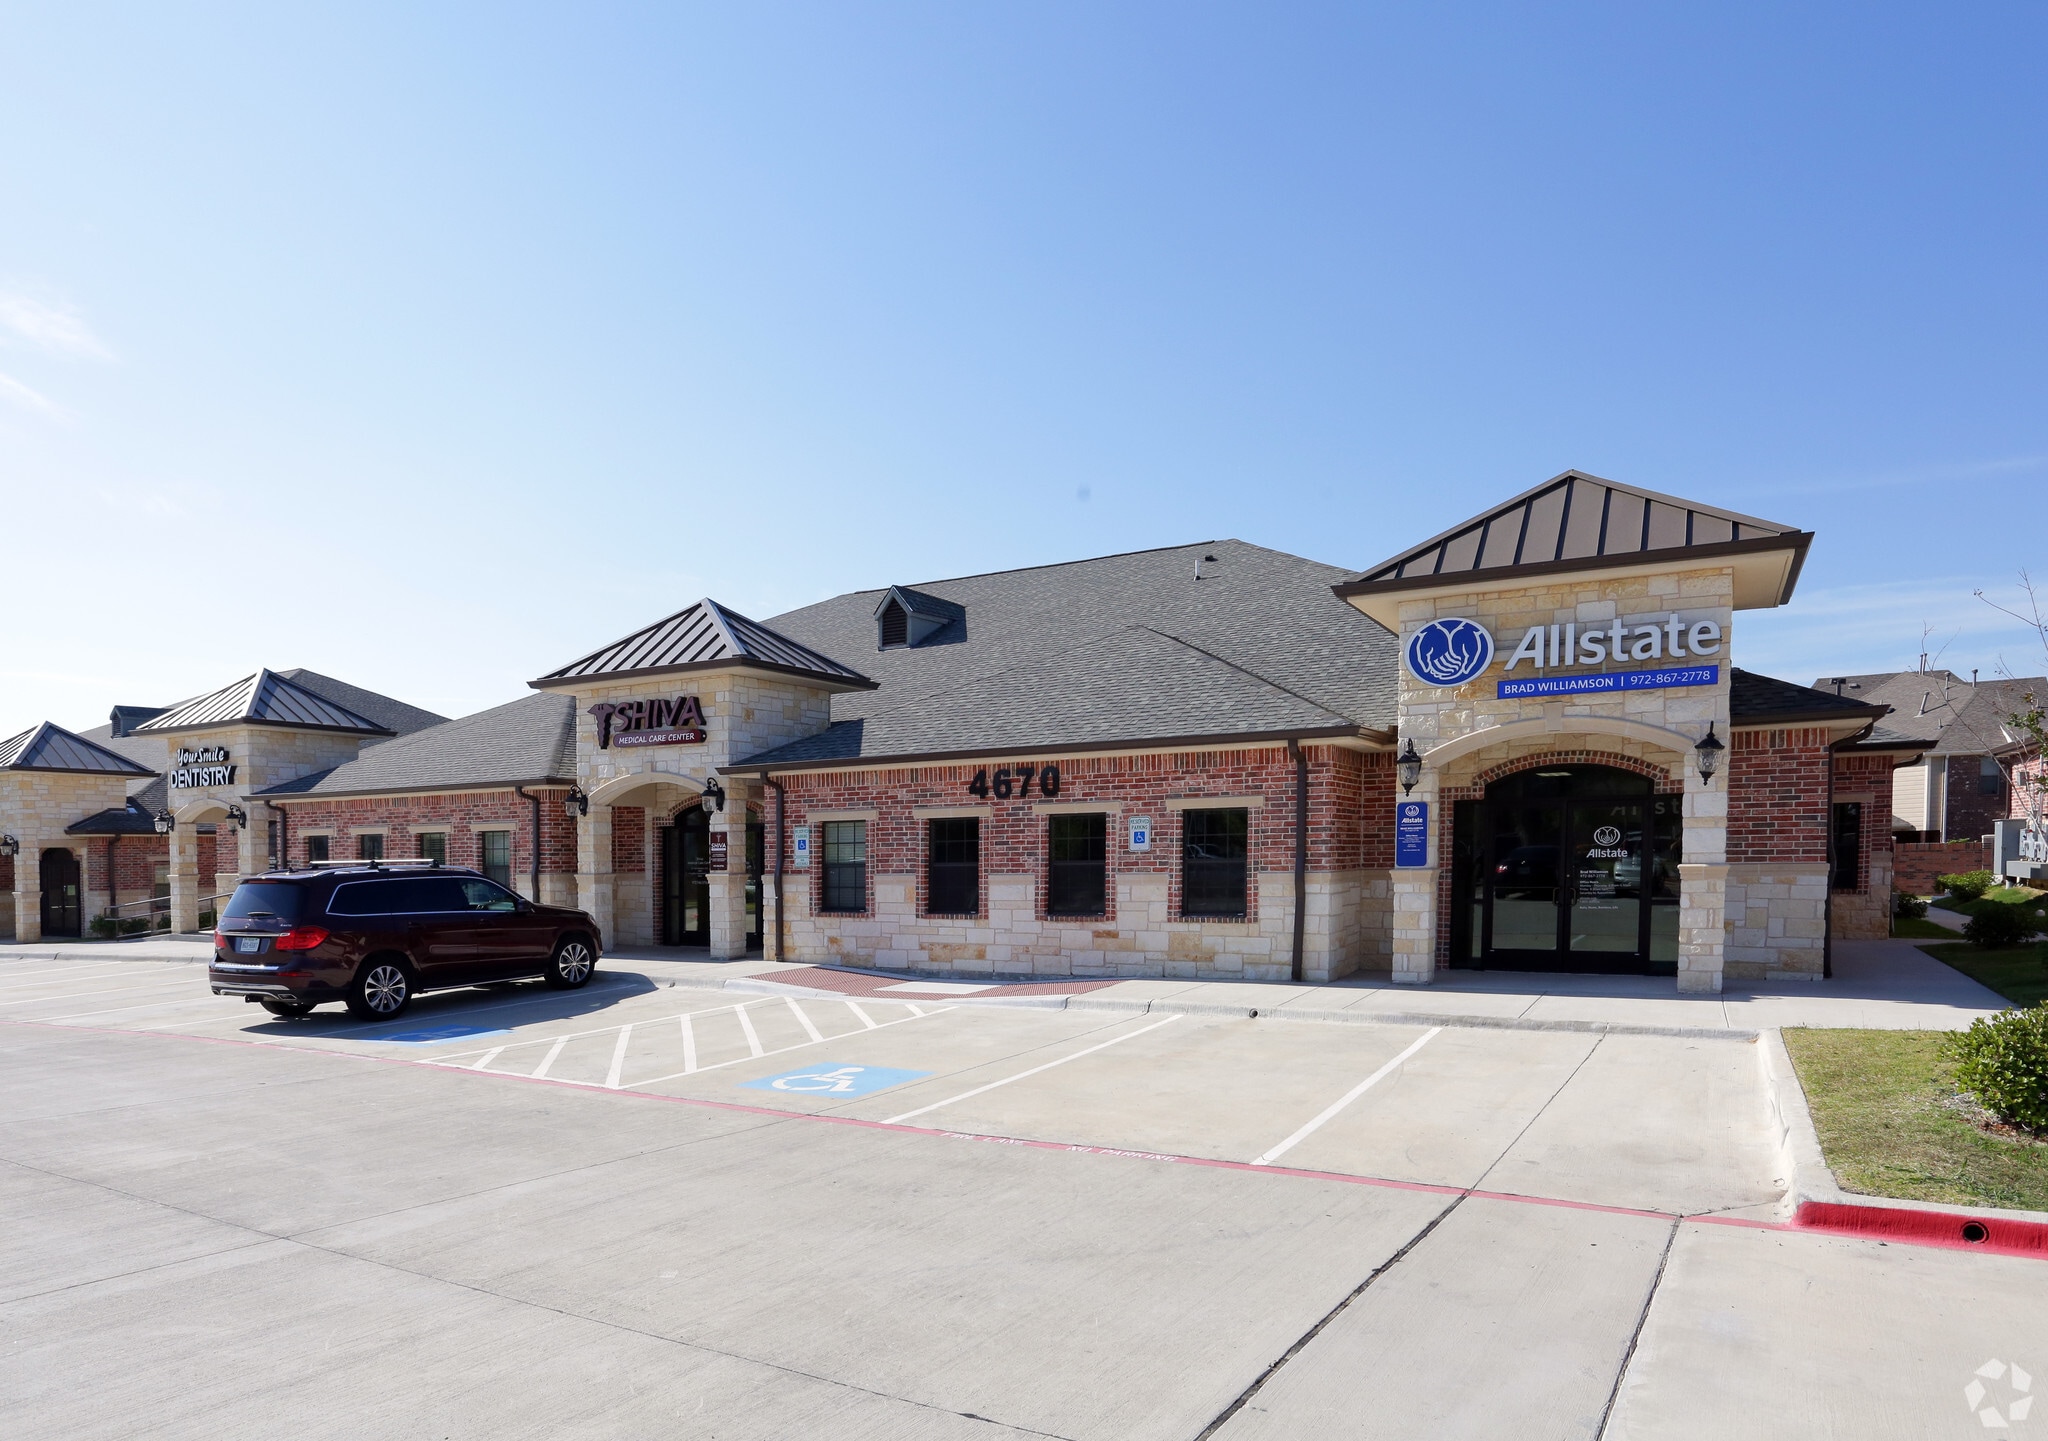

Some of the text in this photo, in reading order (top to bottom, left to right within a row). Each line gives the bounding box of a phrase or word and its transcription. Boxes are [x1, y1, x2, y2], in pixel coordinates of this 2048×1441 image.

[1503, 613, 1722, 671] Allstate
[1504, 670, 1711, 695] BRAD WILLIAMSON 972-867-2778
[613, 695, 706, 732] SHIVA
[618, 732, 695, 744] MEDICAL CARE CENTER
[170, 765, 232, 789] DENTISTRY
[969, 765, 1060, 799] 4670
[1586, 848, 1628, 858] Allstate
